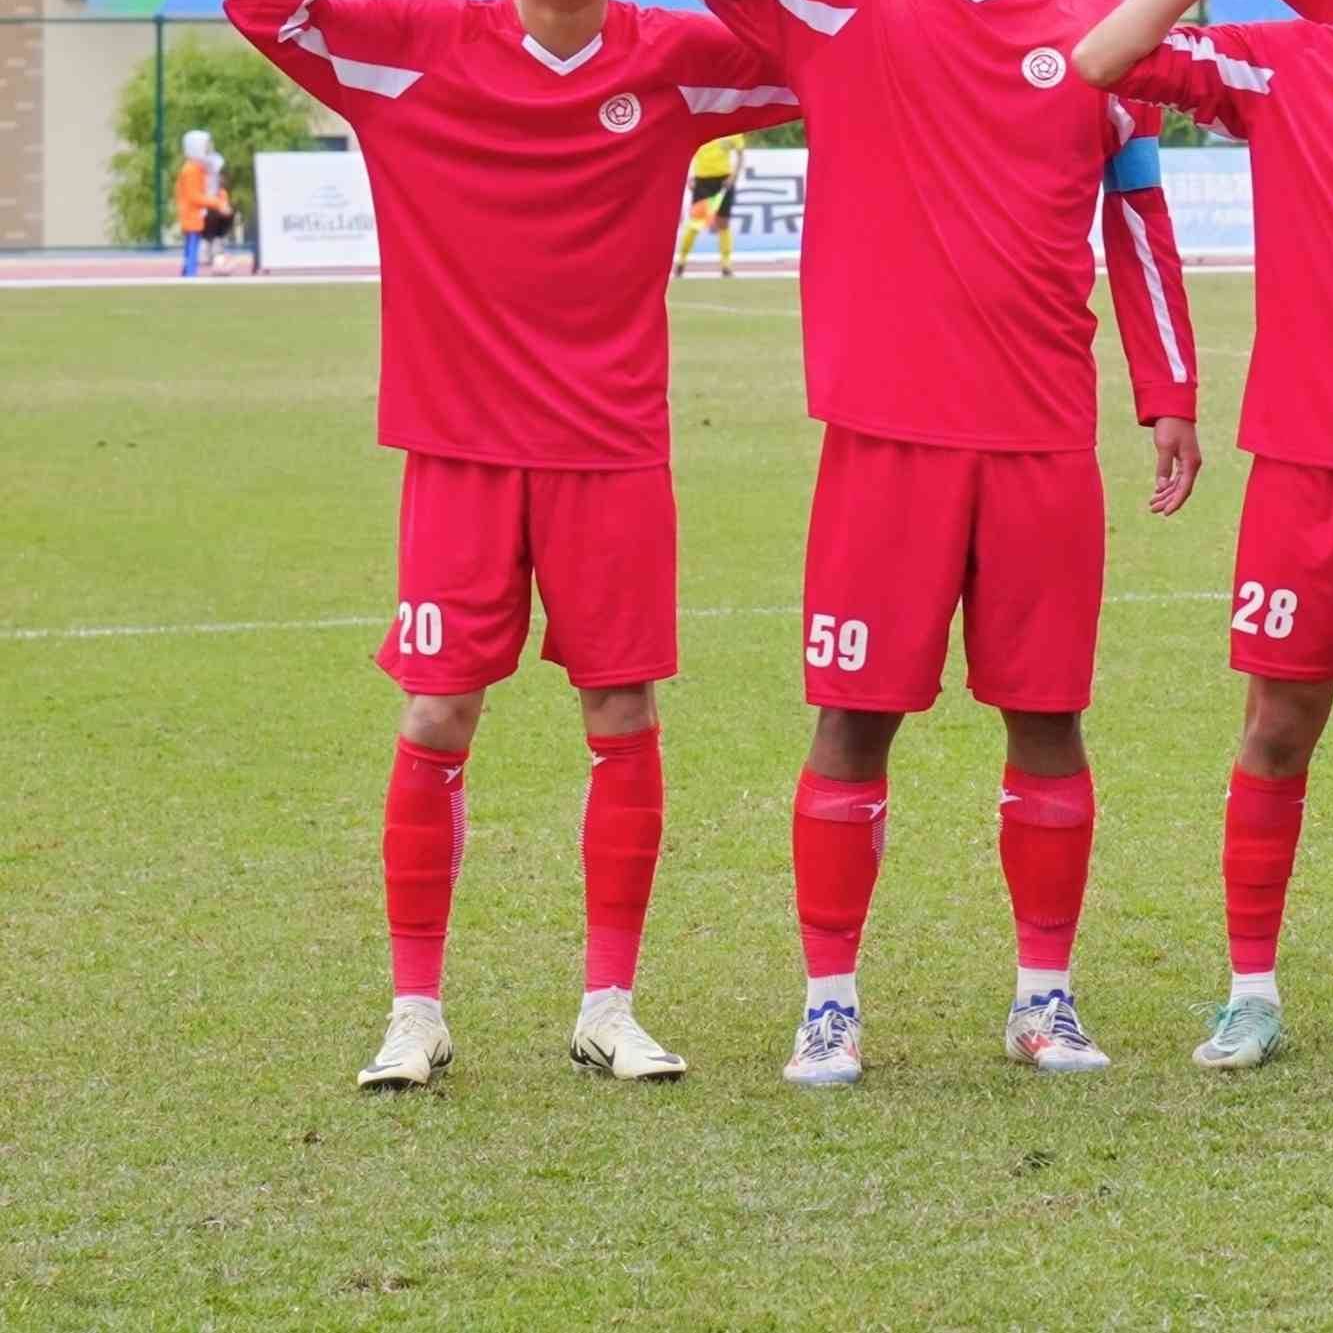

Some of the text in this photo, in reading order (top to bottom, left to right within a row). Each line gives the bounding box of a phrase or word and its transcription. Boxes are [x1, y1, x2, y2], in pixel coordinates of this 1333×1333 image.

[399, 600, 443, 656] 20
[1230, 579, 1299, 640] 28
[805, 613, 870, 671] 59
